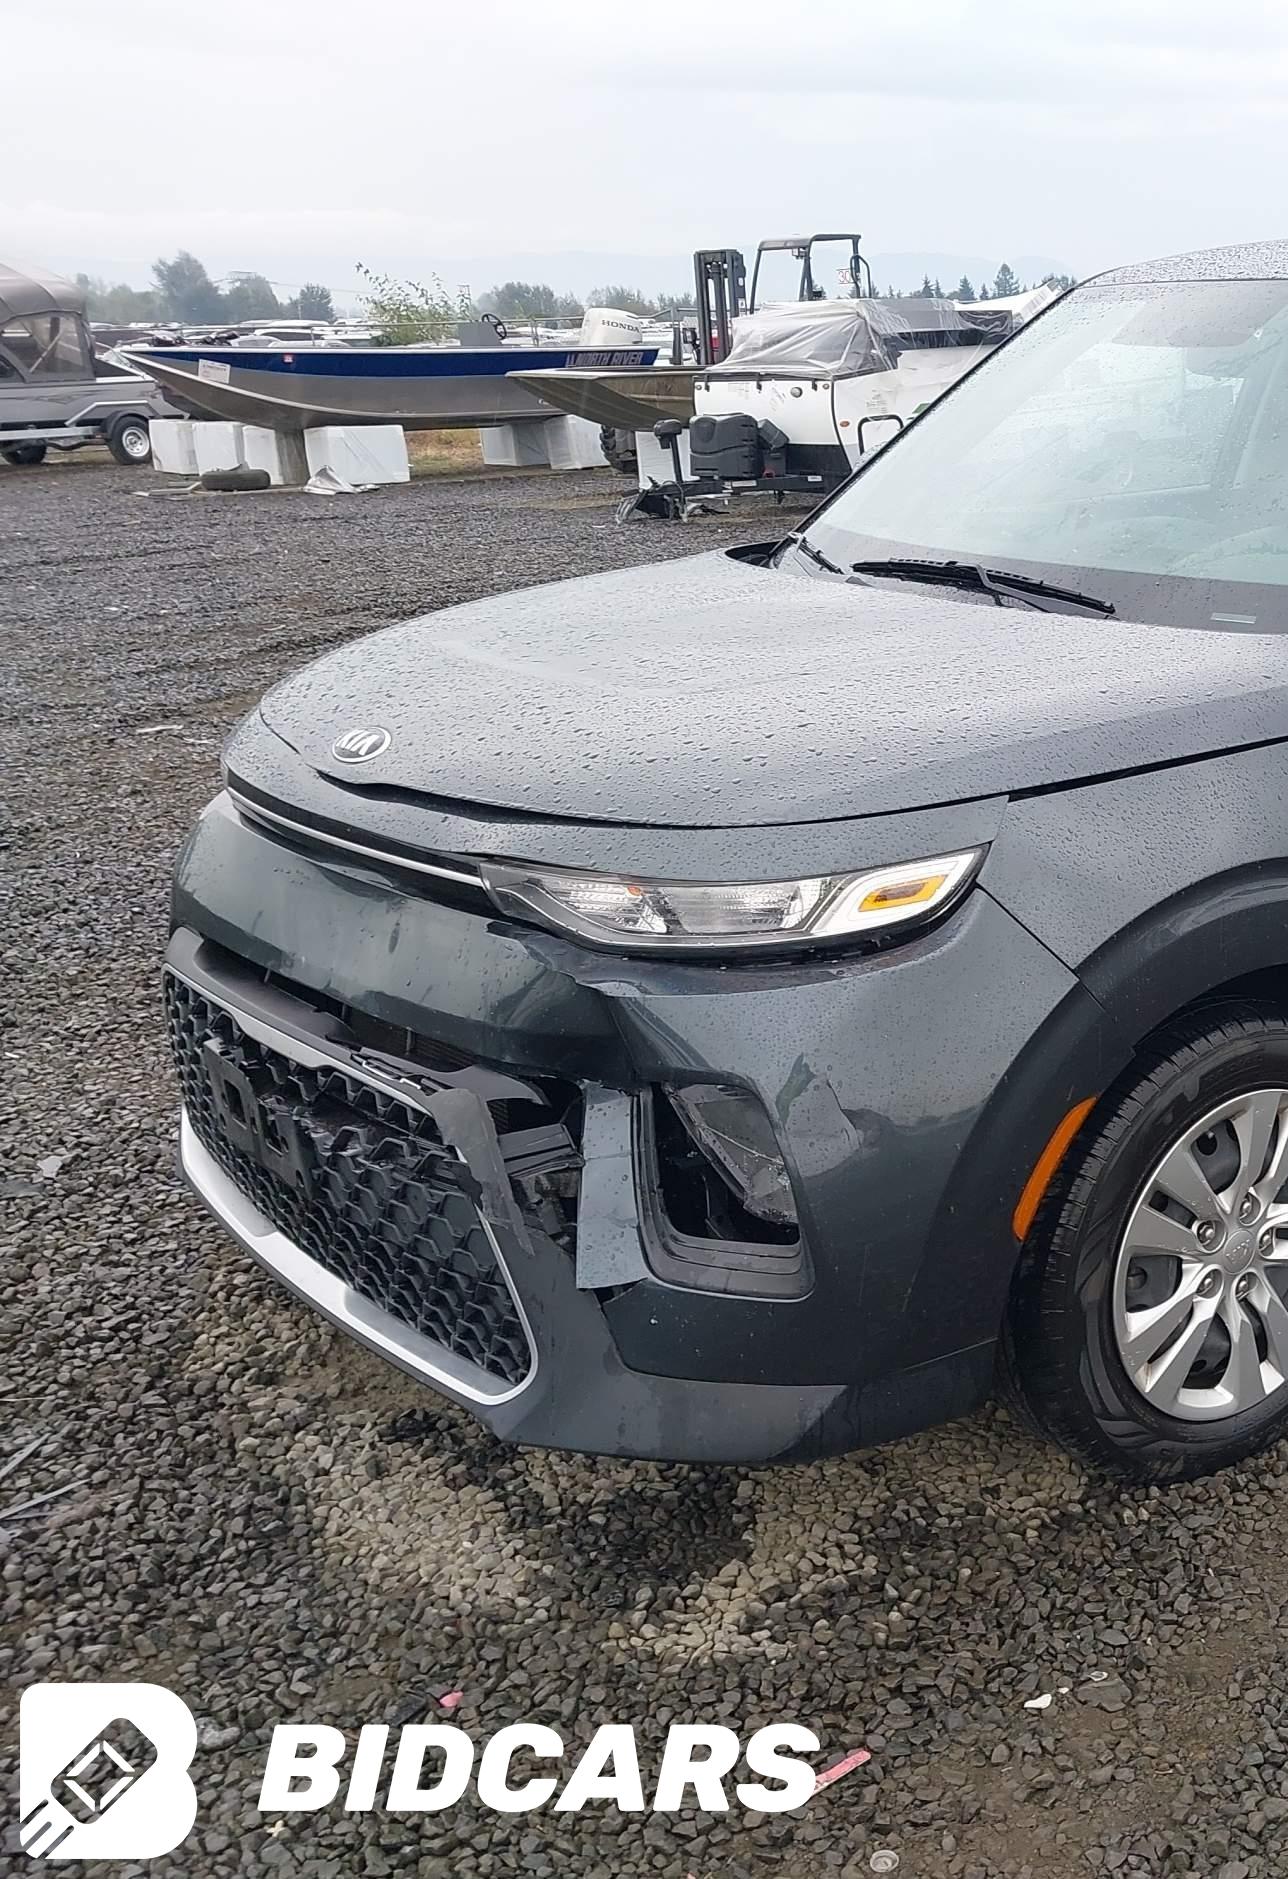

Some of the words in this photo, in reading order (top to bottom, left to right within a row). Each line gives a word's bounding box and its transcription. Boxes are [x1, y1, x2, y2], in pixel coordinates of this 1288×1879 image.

[601, 319, 641, 334] HONDA
[576, 351, 611, 366] NORTH
[611, 351, 644, 366] RIVER
[335, 729, 380, 756] KIA
